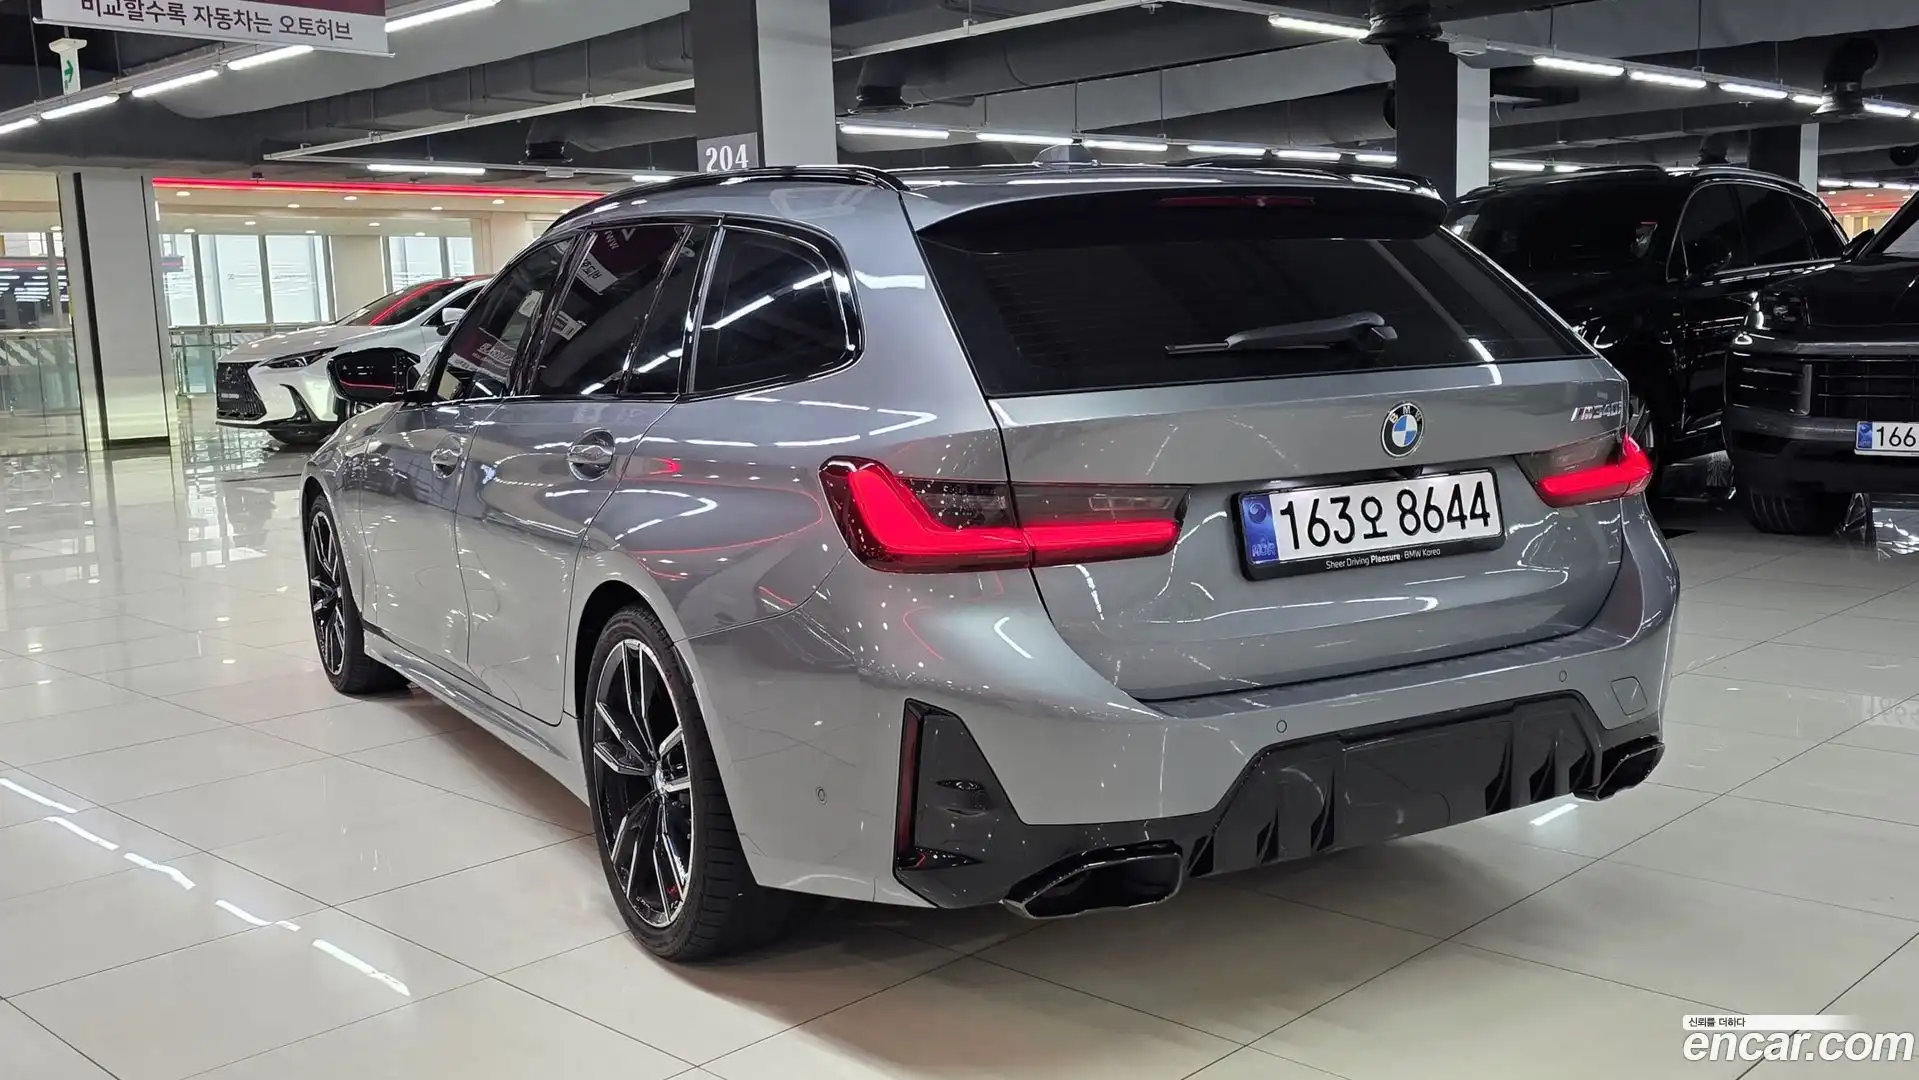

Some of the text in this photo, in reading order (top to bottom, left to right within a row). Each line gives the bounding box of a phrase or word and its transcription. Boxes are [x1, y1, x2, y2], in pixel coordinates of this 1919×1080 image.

[81, 0, 353, 41] 비교할수록 자동차는 오토허브
[705, 143, 749, 174] 204
[1876, 426, 1917, 448] 166
[1279, 480, 1491, 550] 163오 8644
[1325, 547, 1441, 570] Sheer Driving Pleasure BMW Korea
